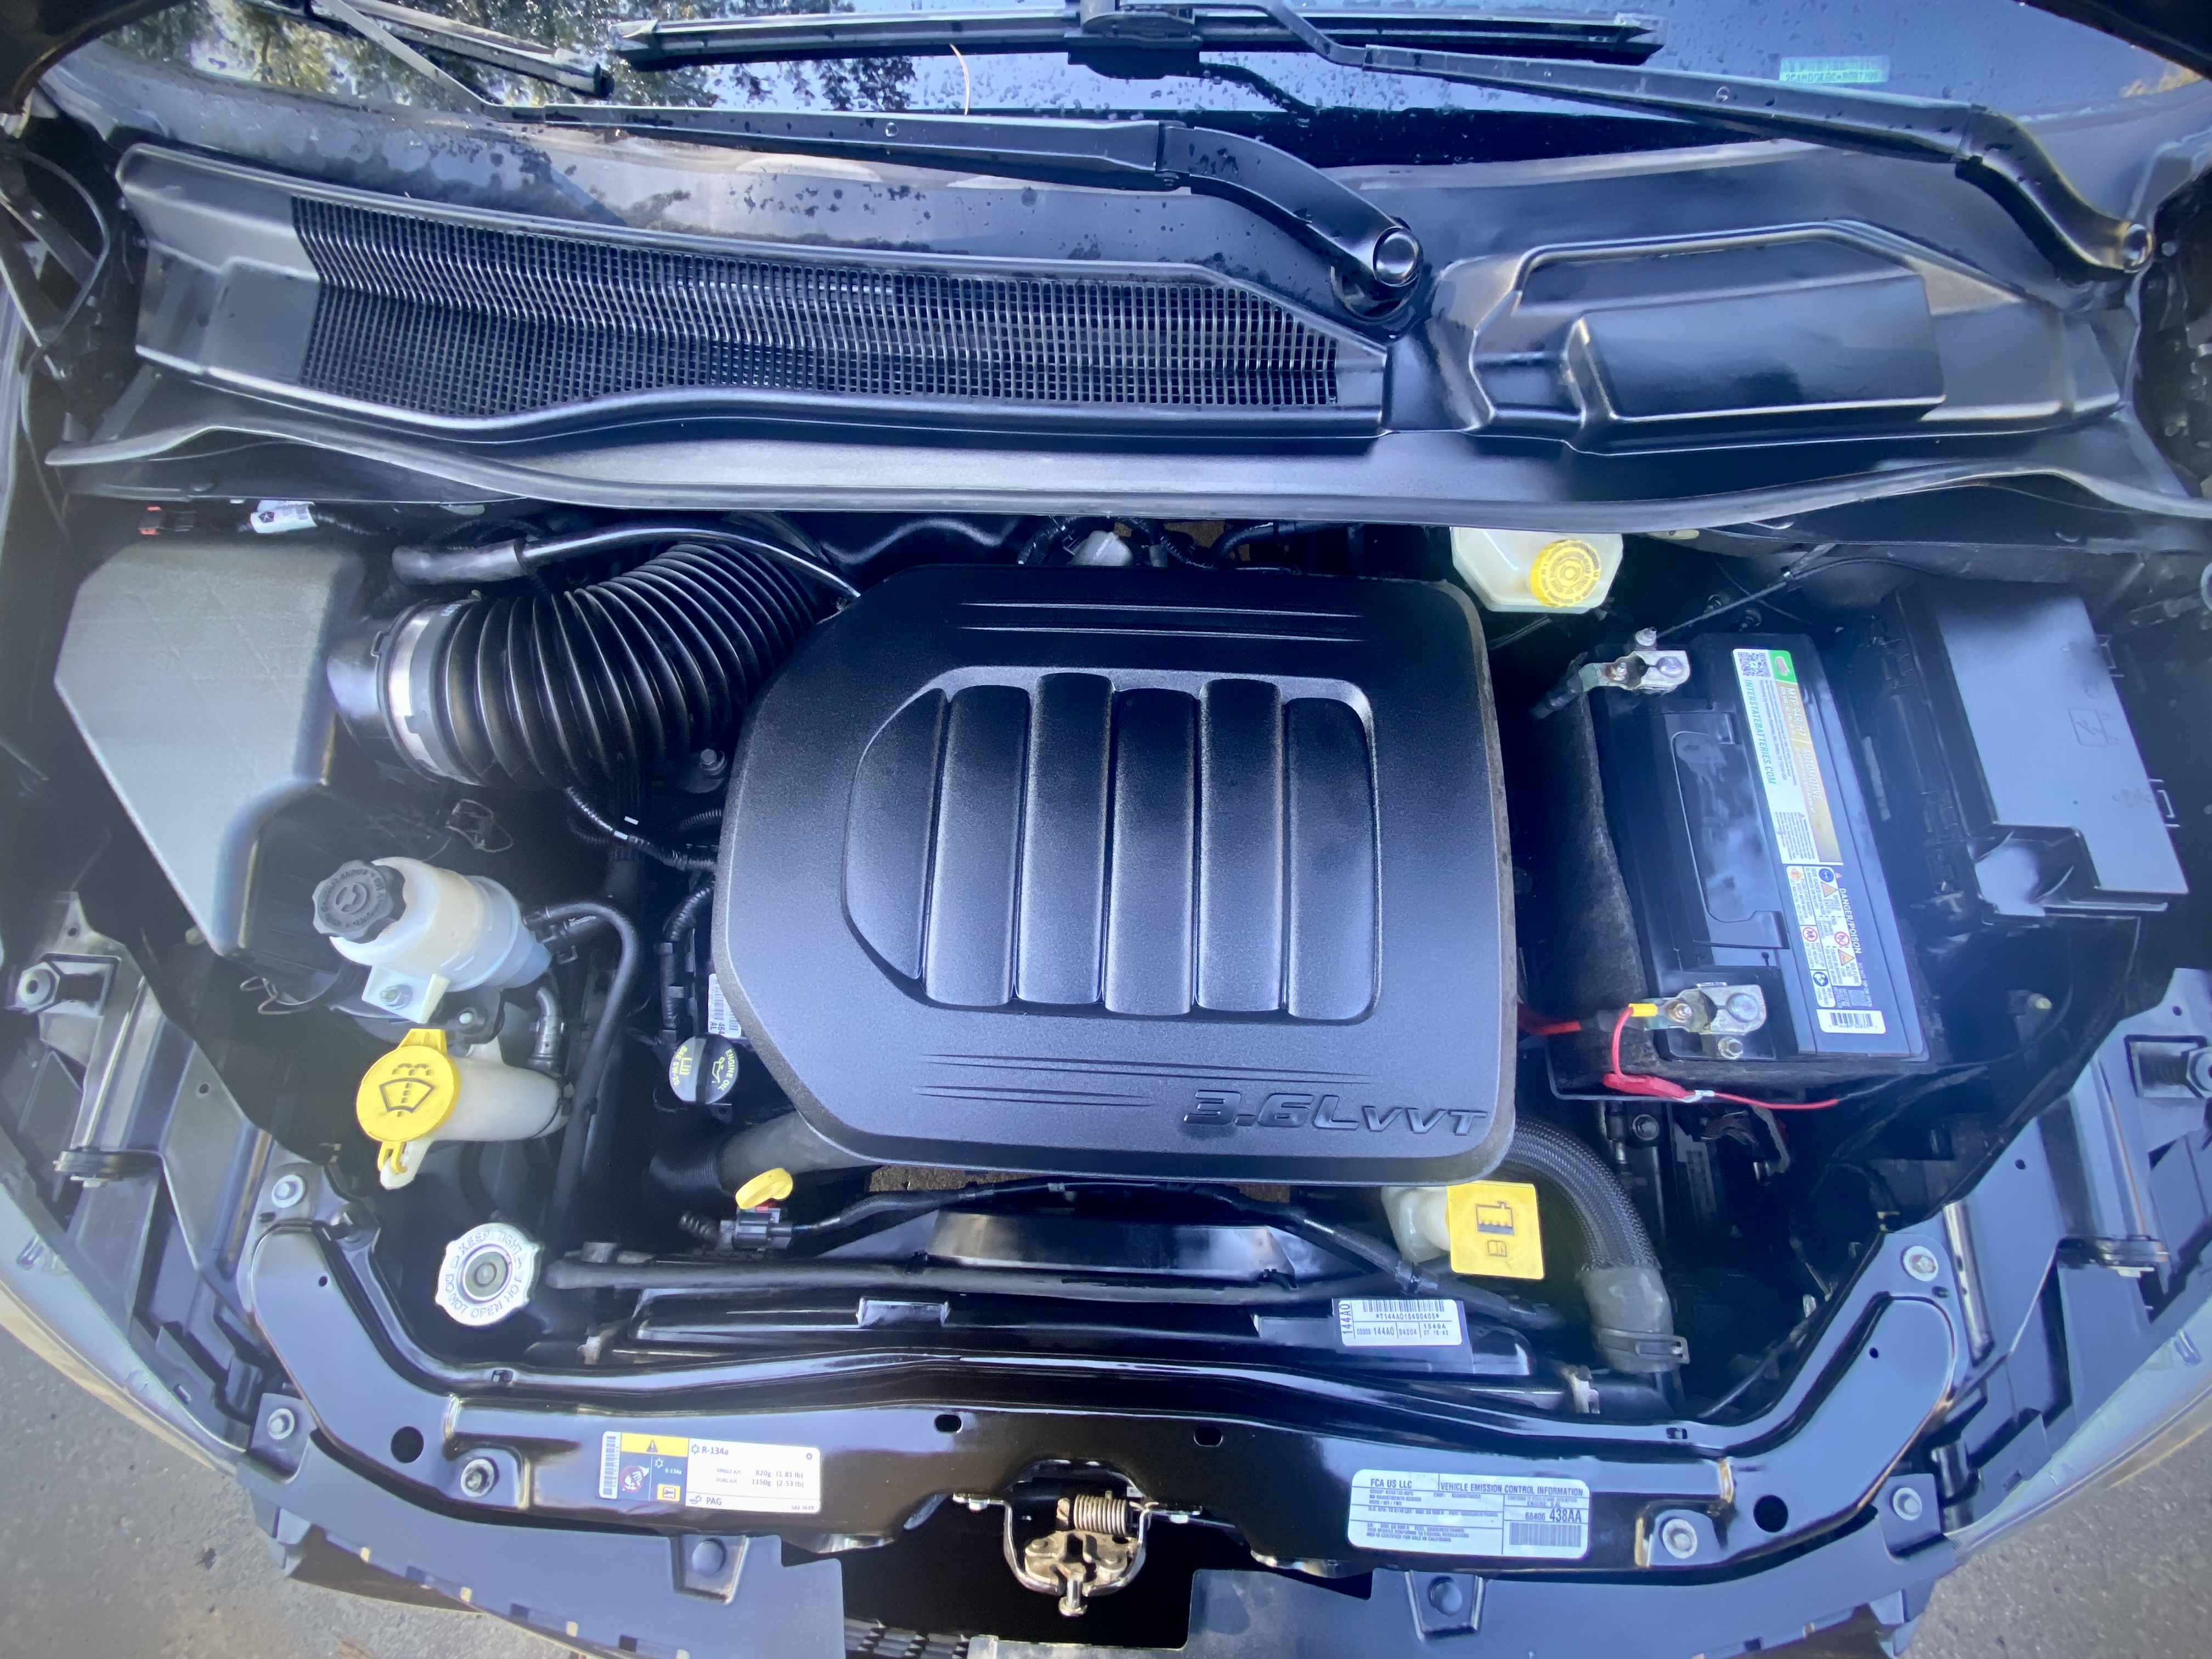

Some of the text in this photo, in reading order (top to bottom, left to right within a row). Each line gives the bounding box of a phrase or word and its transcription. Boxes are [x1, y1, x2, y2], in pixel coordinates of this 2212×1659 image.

[1745, 680, 1776, 783] INTERSTATEBATTERIES.COM
[1802, 748, 1822, 801] AUTOMOTIVE
[1839, 888, 1861, 953] DANGER/POISON
[672, 1045, 687, 1085] SAE 5W-20
[718, 1049, 735, 1091] ENGINE OIL
[1183, 1090, 1488, 1136] 3.6L VVT
[458, 1231, 490, 1254] KEEP
[445, 1274, 521, 1318] DO NOT OPEN HOT
[702, 1446, 729, 1455] R-134a
[752, 1479, 771, 1487] 1150g
[755, 1470, 771, 1478] 820g
[1371, 1479, 1412, 1489] FCA US LLC
[1441, 1482, 1583, 1496] VEHICLE EMISSION CONTROL INFORMATION
[706, 1497, 722, 1505] PAG
[1550, 1508, 1582, 1522] 438AA
